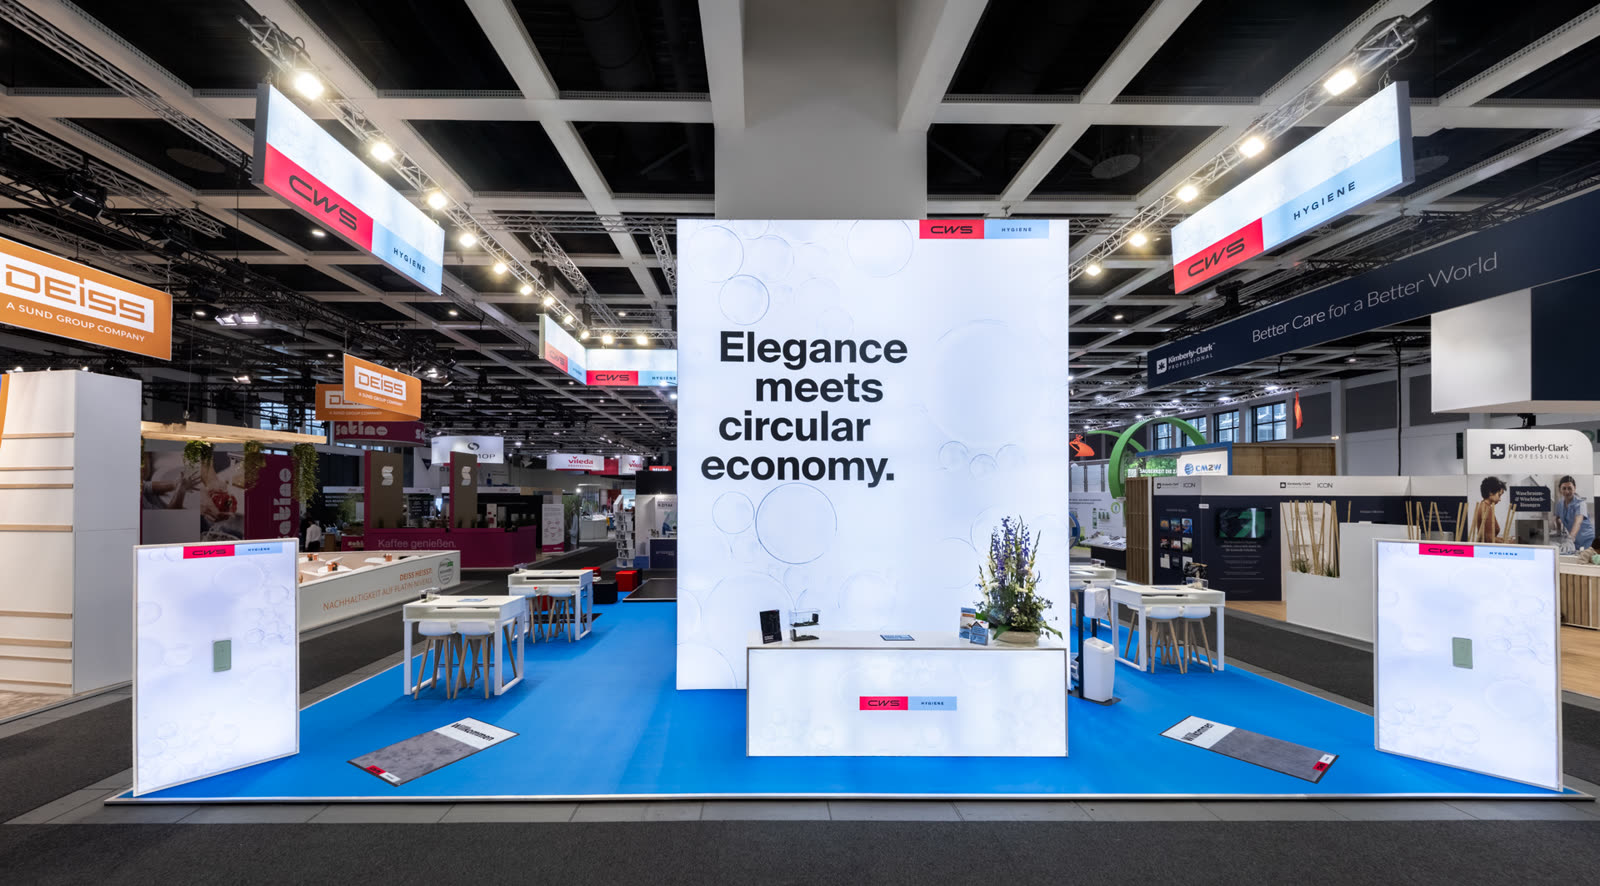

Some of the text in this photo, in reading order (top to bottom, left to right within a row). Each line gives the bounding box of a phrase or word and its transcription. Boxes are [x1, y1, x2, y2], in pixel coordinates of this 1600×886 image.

[289, 175, 357, 231] CWS
[1293, 181, 1356, 221] HYGIENE
[930, 225, 973, 234] CWS
[393, 247, 426, 273] HYGIENE
[1188, 238, 1245, 277] CWS
[1252, 252, 1497, 342] Better Care for a Better World
[6, 302, 145, 342] A SUND GROUP COMPANY
[720, 331, 908, 370] Elegance
[1168, 353, 1214, 370] PROFESSIONAL
[756, 373, 883, 402] meets
[719, 410, 871, 441] circular
[701, 455, 894, 488] economy.
[1195, 464, 1222, 472] CM2W
[273, 468, 292, 538] atino
[378, 539, 456, 549] Kaffee genießen.
[400, 573, 414, 581] DEISS
[323, 589, 380, 611] NACHHALTIGKEIT
